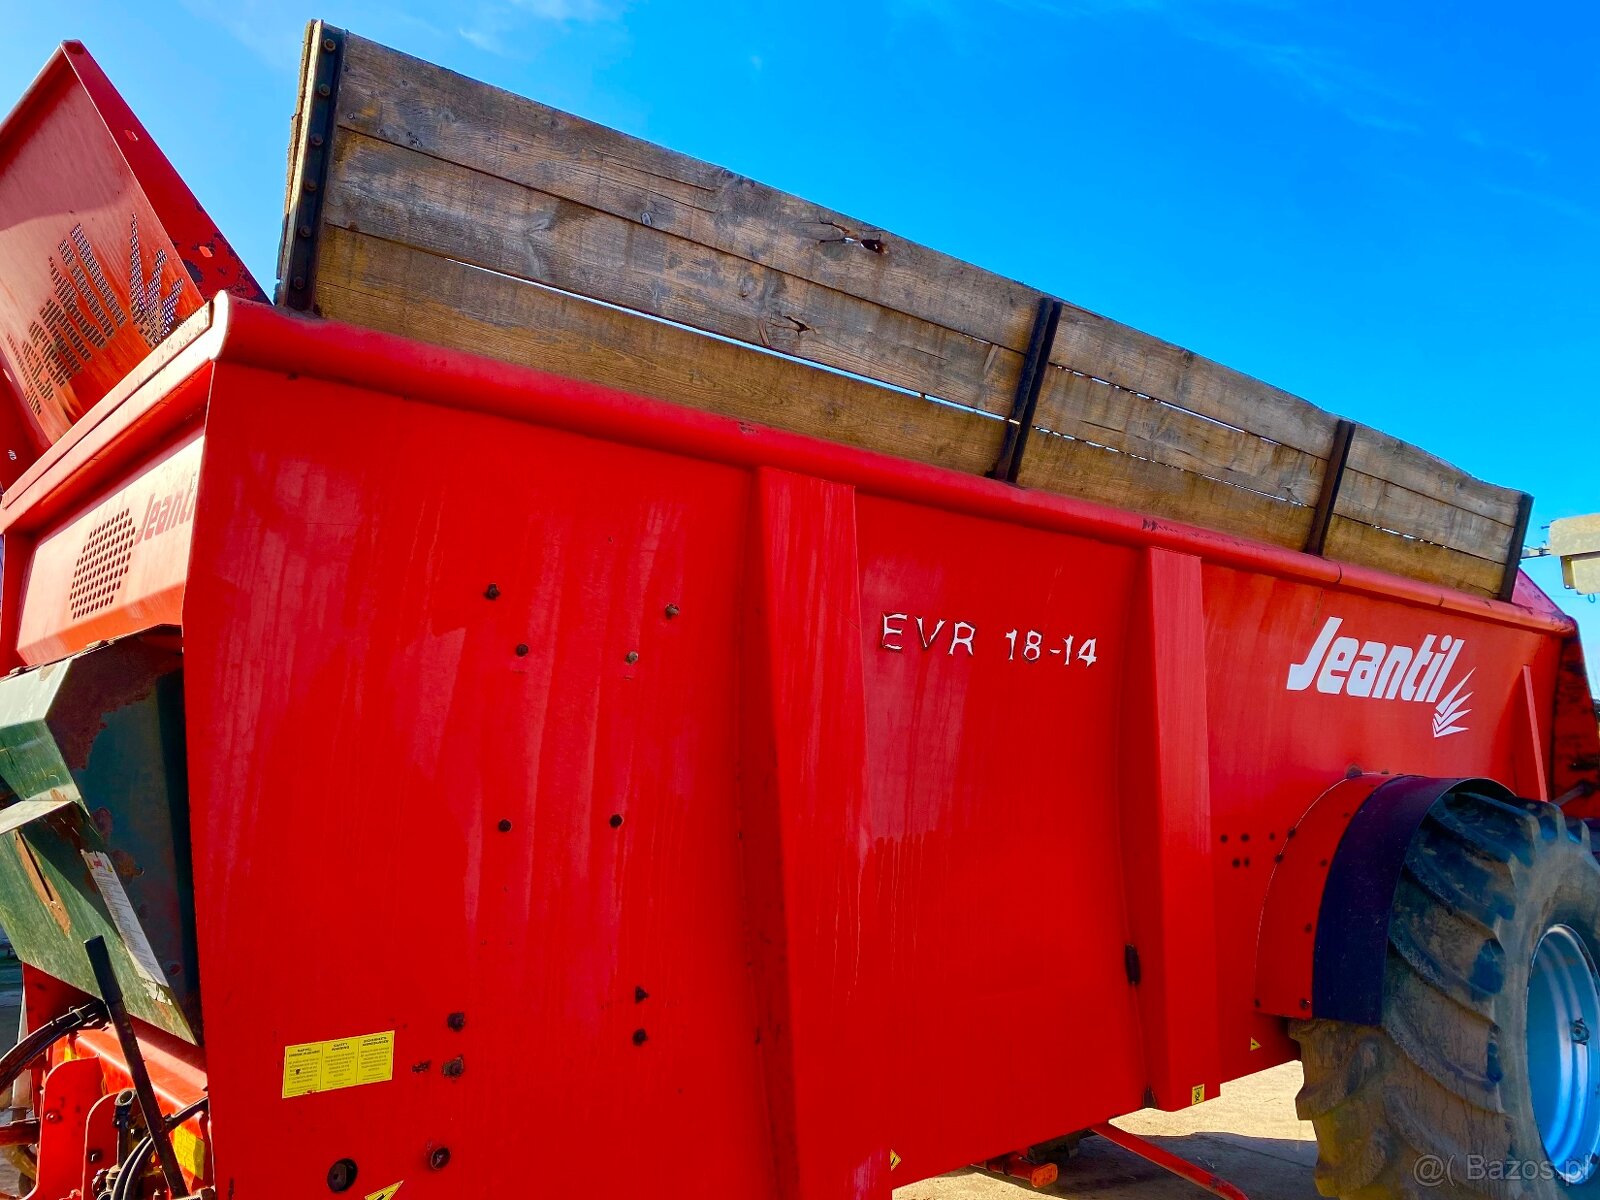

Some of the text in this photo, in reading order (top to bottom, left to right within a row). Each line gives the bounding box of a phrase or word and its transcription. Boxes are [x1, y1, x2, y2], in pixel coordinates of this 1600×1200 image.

[882, 613, 1098, 667] EVR 18-14
[1286, 616, 1465, 703] Jeantil
